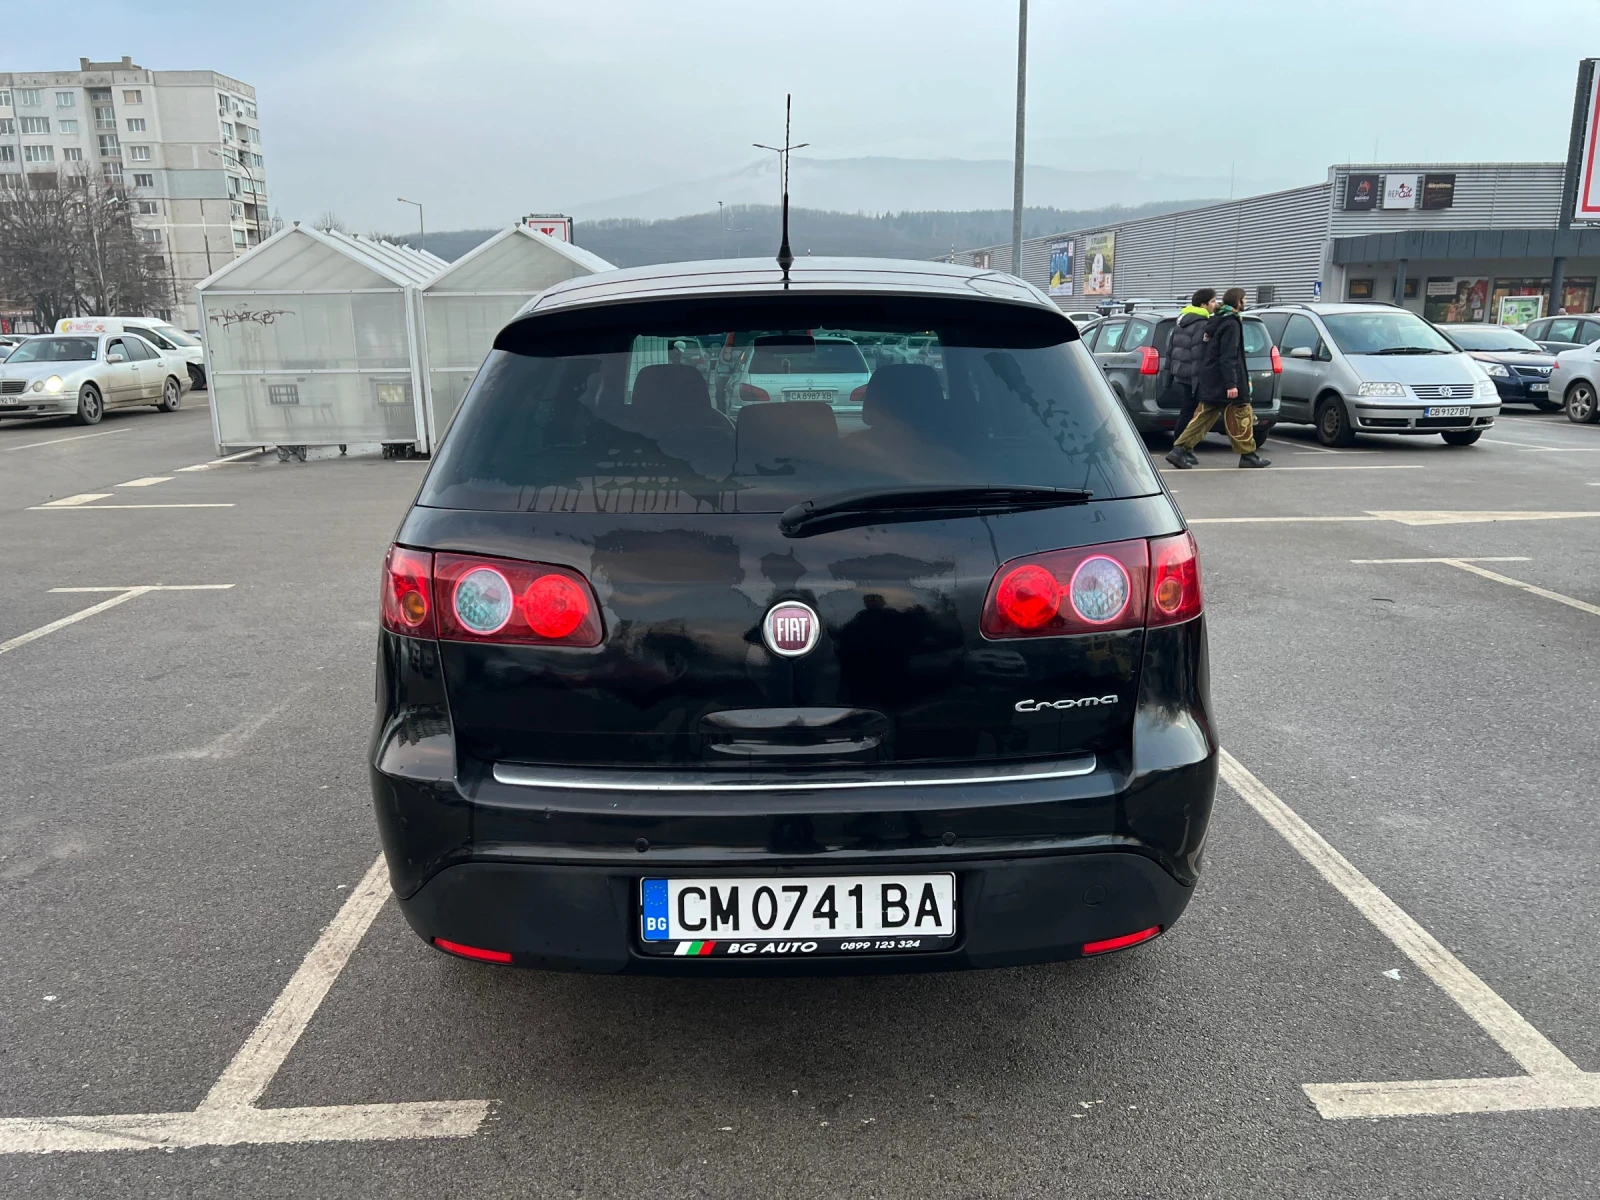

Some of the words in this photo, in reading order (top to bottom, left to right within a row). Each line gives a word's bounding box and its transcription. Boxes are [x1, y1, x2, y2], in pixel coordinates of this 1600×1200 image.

[1441, 407, 1459, 416] 9127
[777, 617, 807, 641] FIAT
[1015, 695, 1118, 712] Croma
[677, 886, 740, 932] CM
[752, 883, 863, 931] 0741
[881, 882, 942, 928] BA
[647, 917, 667, 931] BG
[727, 943, 757, 954] BG
[760, 941, 818, 953] AUTO
[840, 942, 871, 950] 0899
[875, 940, 895, 949] 123
[897, 939, 921, 948] 324
